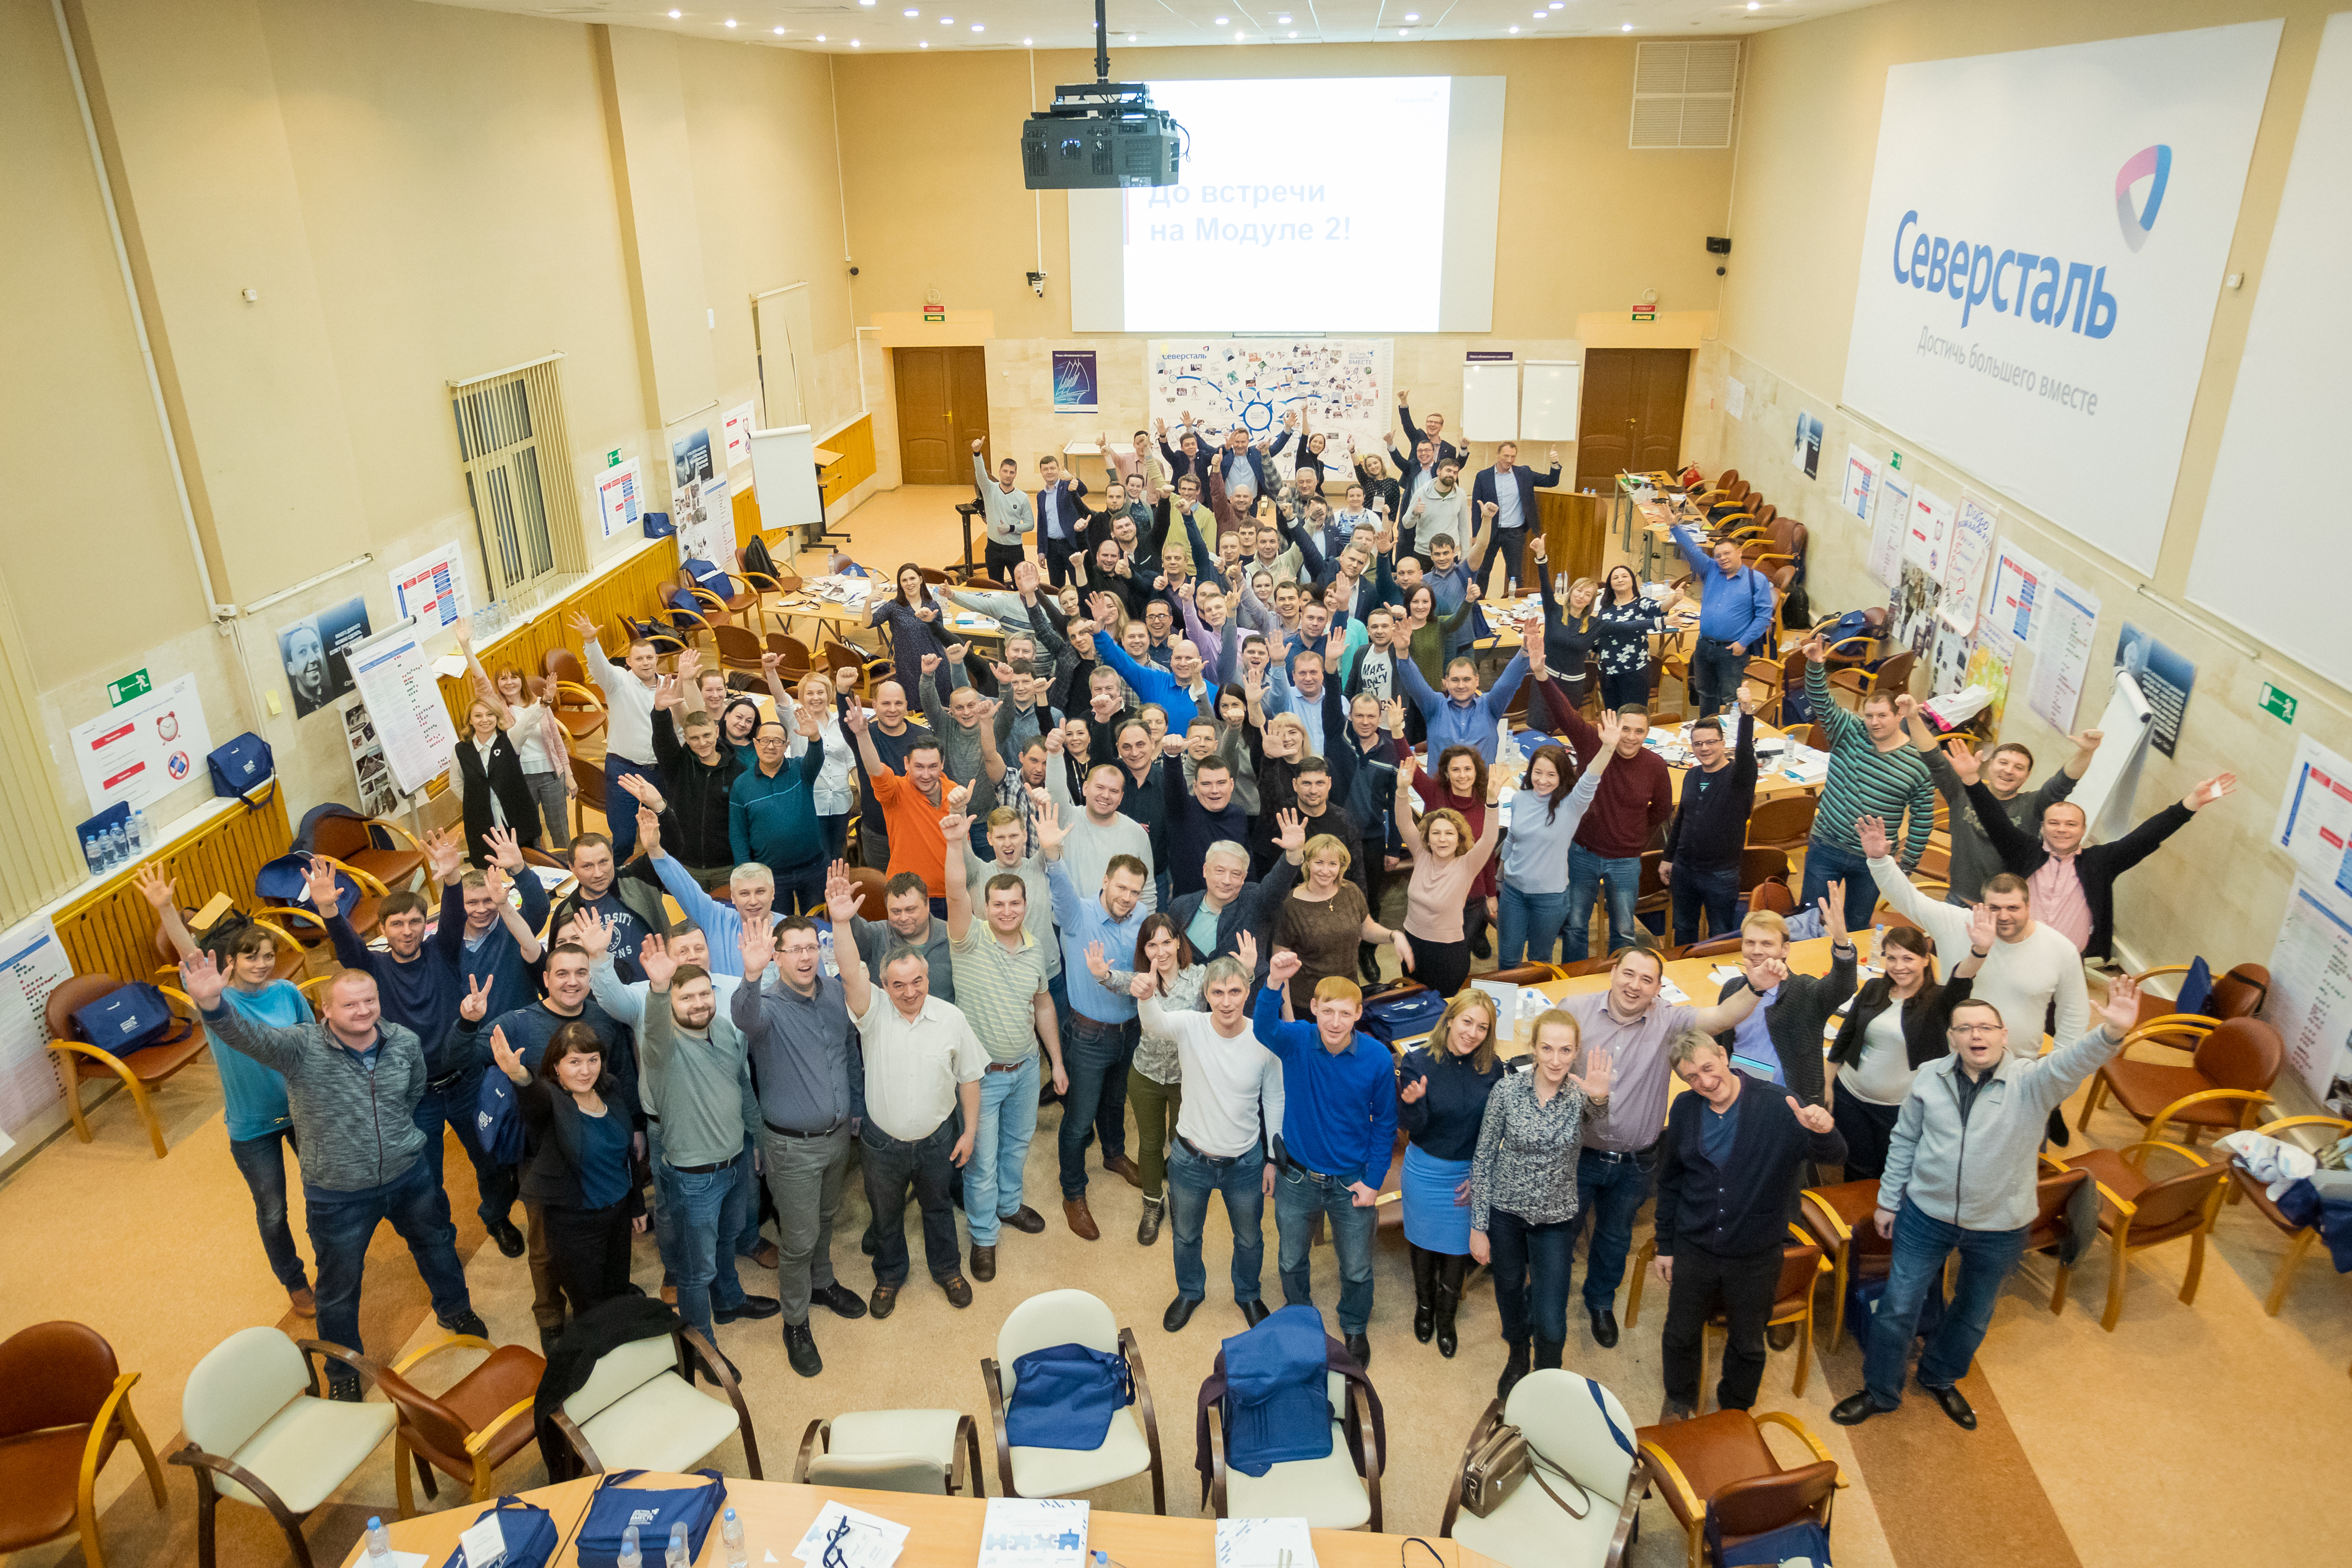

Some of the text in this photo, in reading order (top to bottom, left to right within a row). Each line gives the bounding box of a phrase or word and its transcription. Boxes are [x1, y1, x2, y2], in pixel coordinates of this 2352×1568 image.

[1148, 184, 1325, 209] До встречи
[1151, 216, 1350, 247] на Модуле 2!
[1893, 210, 2117, 339] Северсталь
[1917, 325, 2098, 416] Достичь большего вместе
[599, 913, 633, 926] ERSITY
